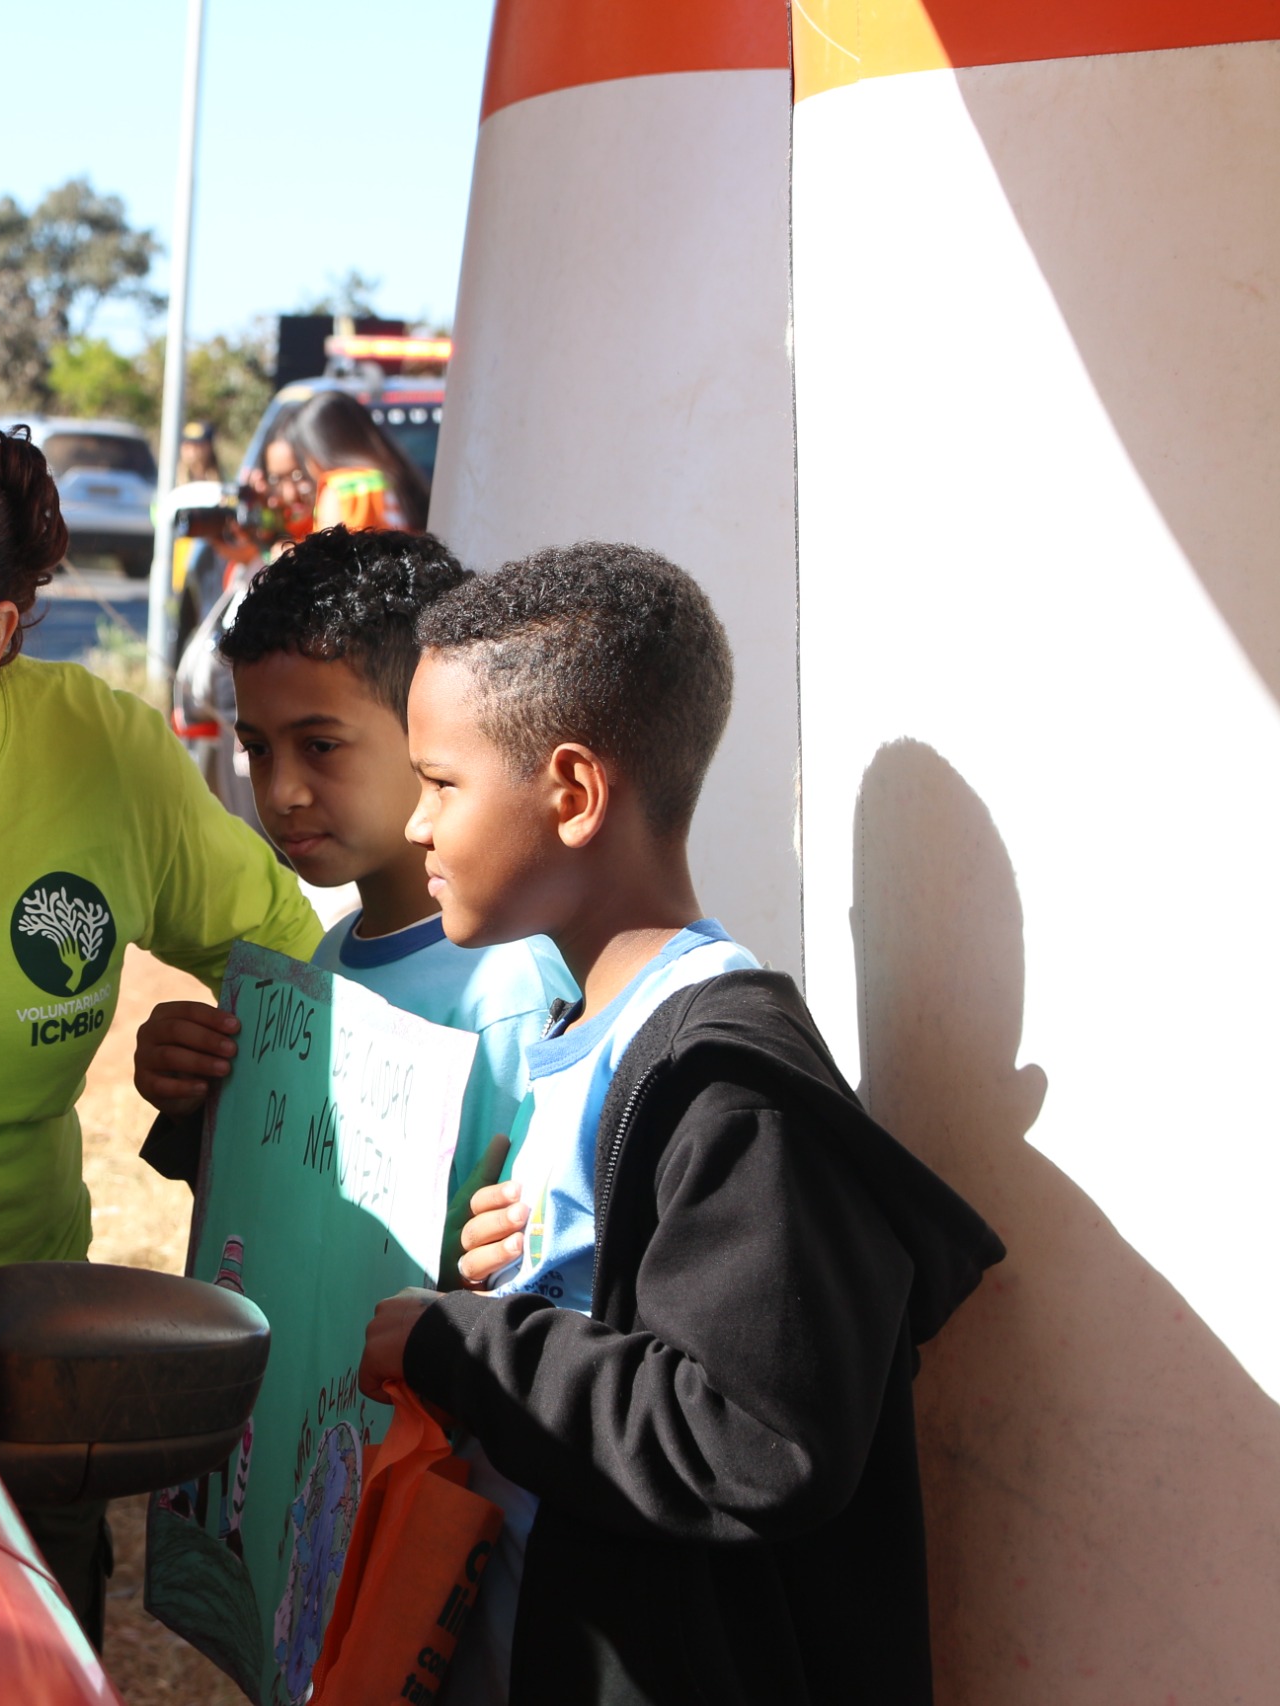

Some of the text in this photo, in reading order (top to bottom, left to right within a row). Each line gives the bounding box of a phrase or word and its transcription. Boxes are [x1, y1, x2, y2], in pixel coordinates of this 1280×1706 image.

[16, 983, 112, 1022] VOLUNTARIADO
[31, 1008, 104, 1047] ICMBio
[252, 979, 315, 1064] TEMOS
[332, 1027, 353, 1081] DE
[261, 1090, 286, 1146] DA
